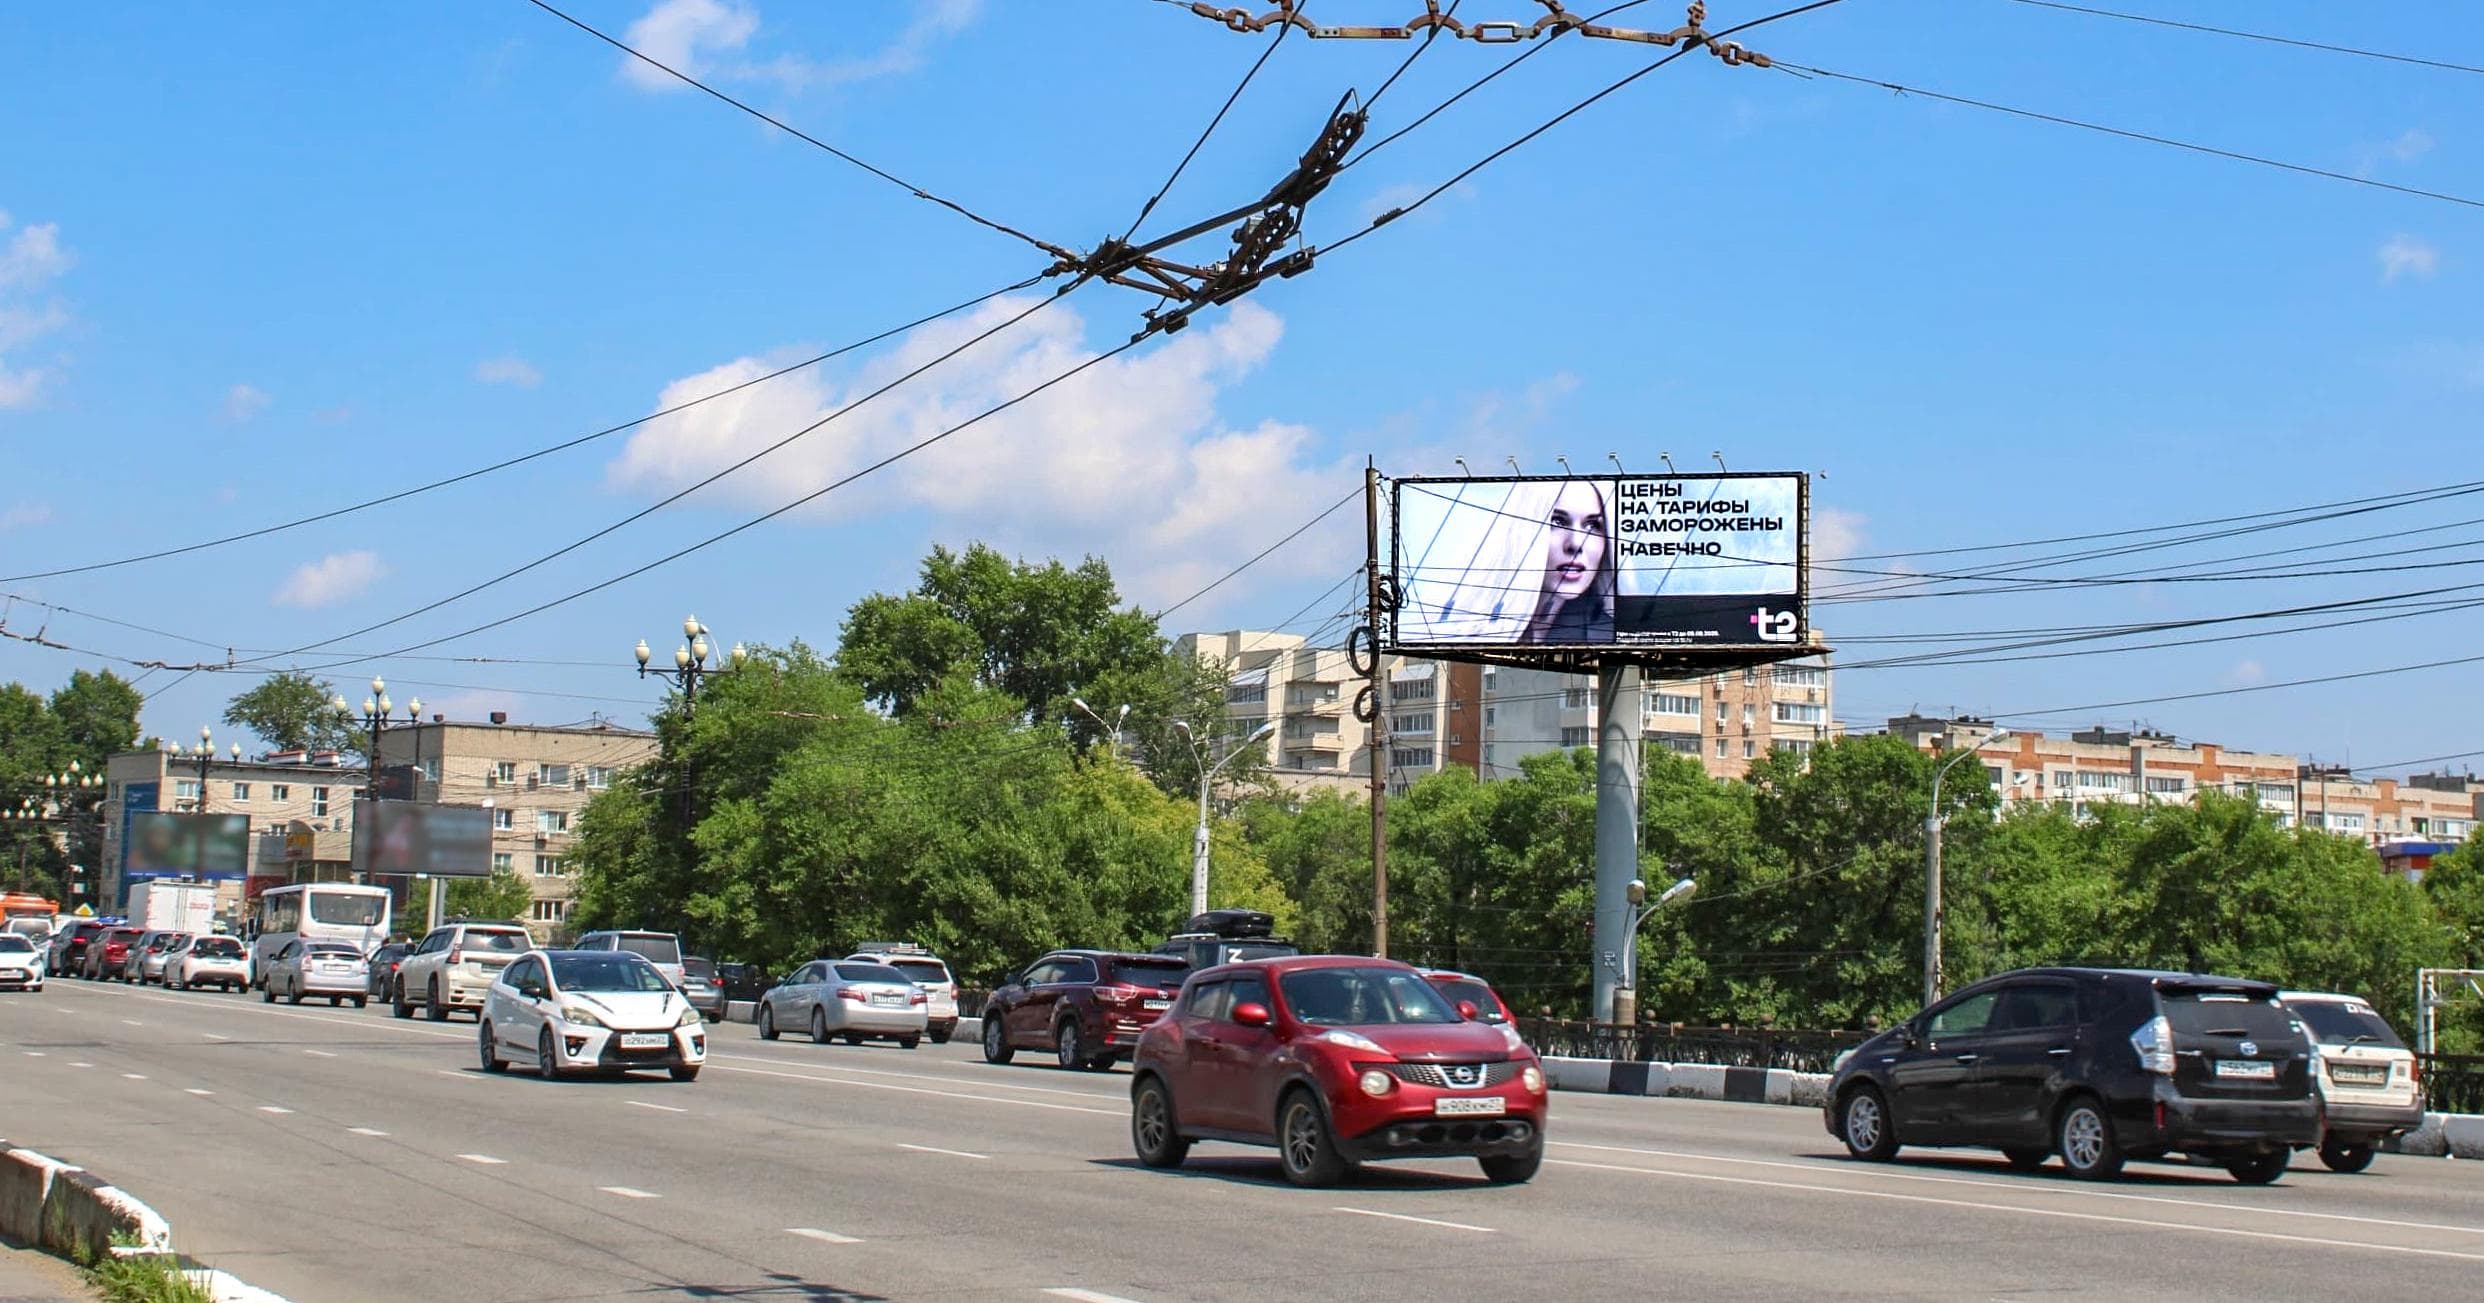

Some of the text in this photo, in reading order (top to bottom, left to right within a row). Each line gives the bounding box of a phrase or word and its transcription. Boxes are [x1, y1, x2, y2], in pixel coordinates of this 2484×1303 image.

[1620, 483, 1682, 499] ЦЕНЫ
[1620, 500, 1749, 515] НА ТАРИФЫ
[1620, 517, 1783, 532] ЗАМОРОЖЕНЫ
[1620, 542, 1722, 556] НАВЕЧНО
[1228, 948, 1244, 963] Z
